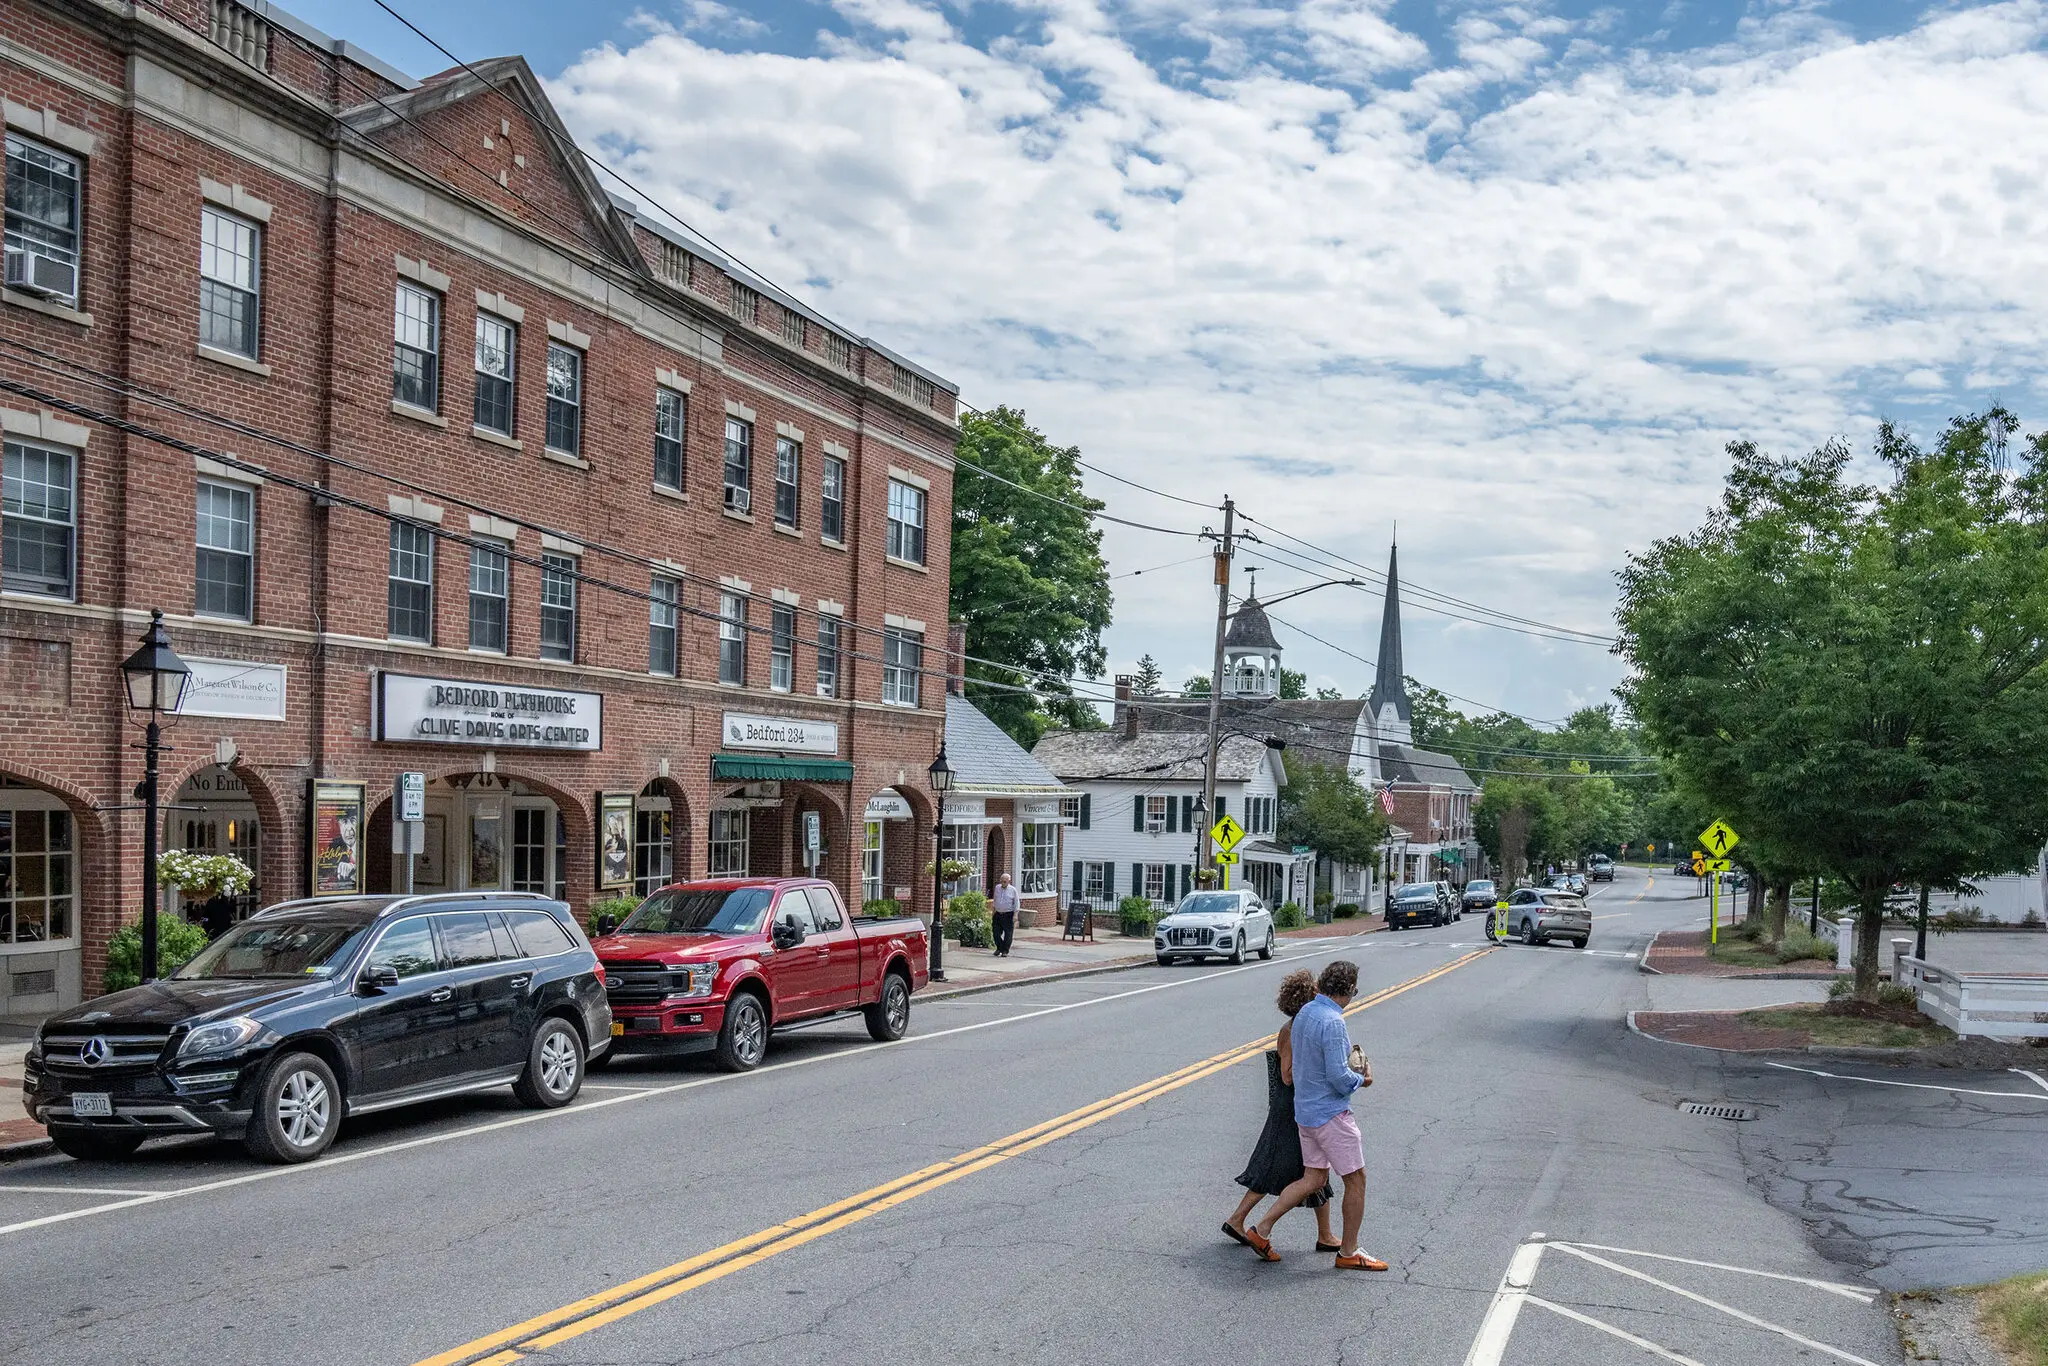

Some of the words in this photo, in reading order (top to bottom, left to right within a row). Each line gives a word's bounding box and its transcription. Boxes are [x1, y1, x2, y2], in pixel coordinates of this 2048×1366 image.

[195, 676, 230, 689] Margaret
[230, 680, 257, 690] Wilson
[258, 682, 264, 691] &
[436, 685, 498, 708] BEDFORD
[504, 692, 577, 714] PLAYHOUSE
[420, 717, 460, 735] CLIVE
[466, 720, 504, 738] DAVIS
[510, 723, 541, 739] ARTS
[544, 726, 589, 742] CENTER
[746, 724, 785, 742] Bedford
[788, 728, 804, 743] 234
[189, 774, 210, 790] No
